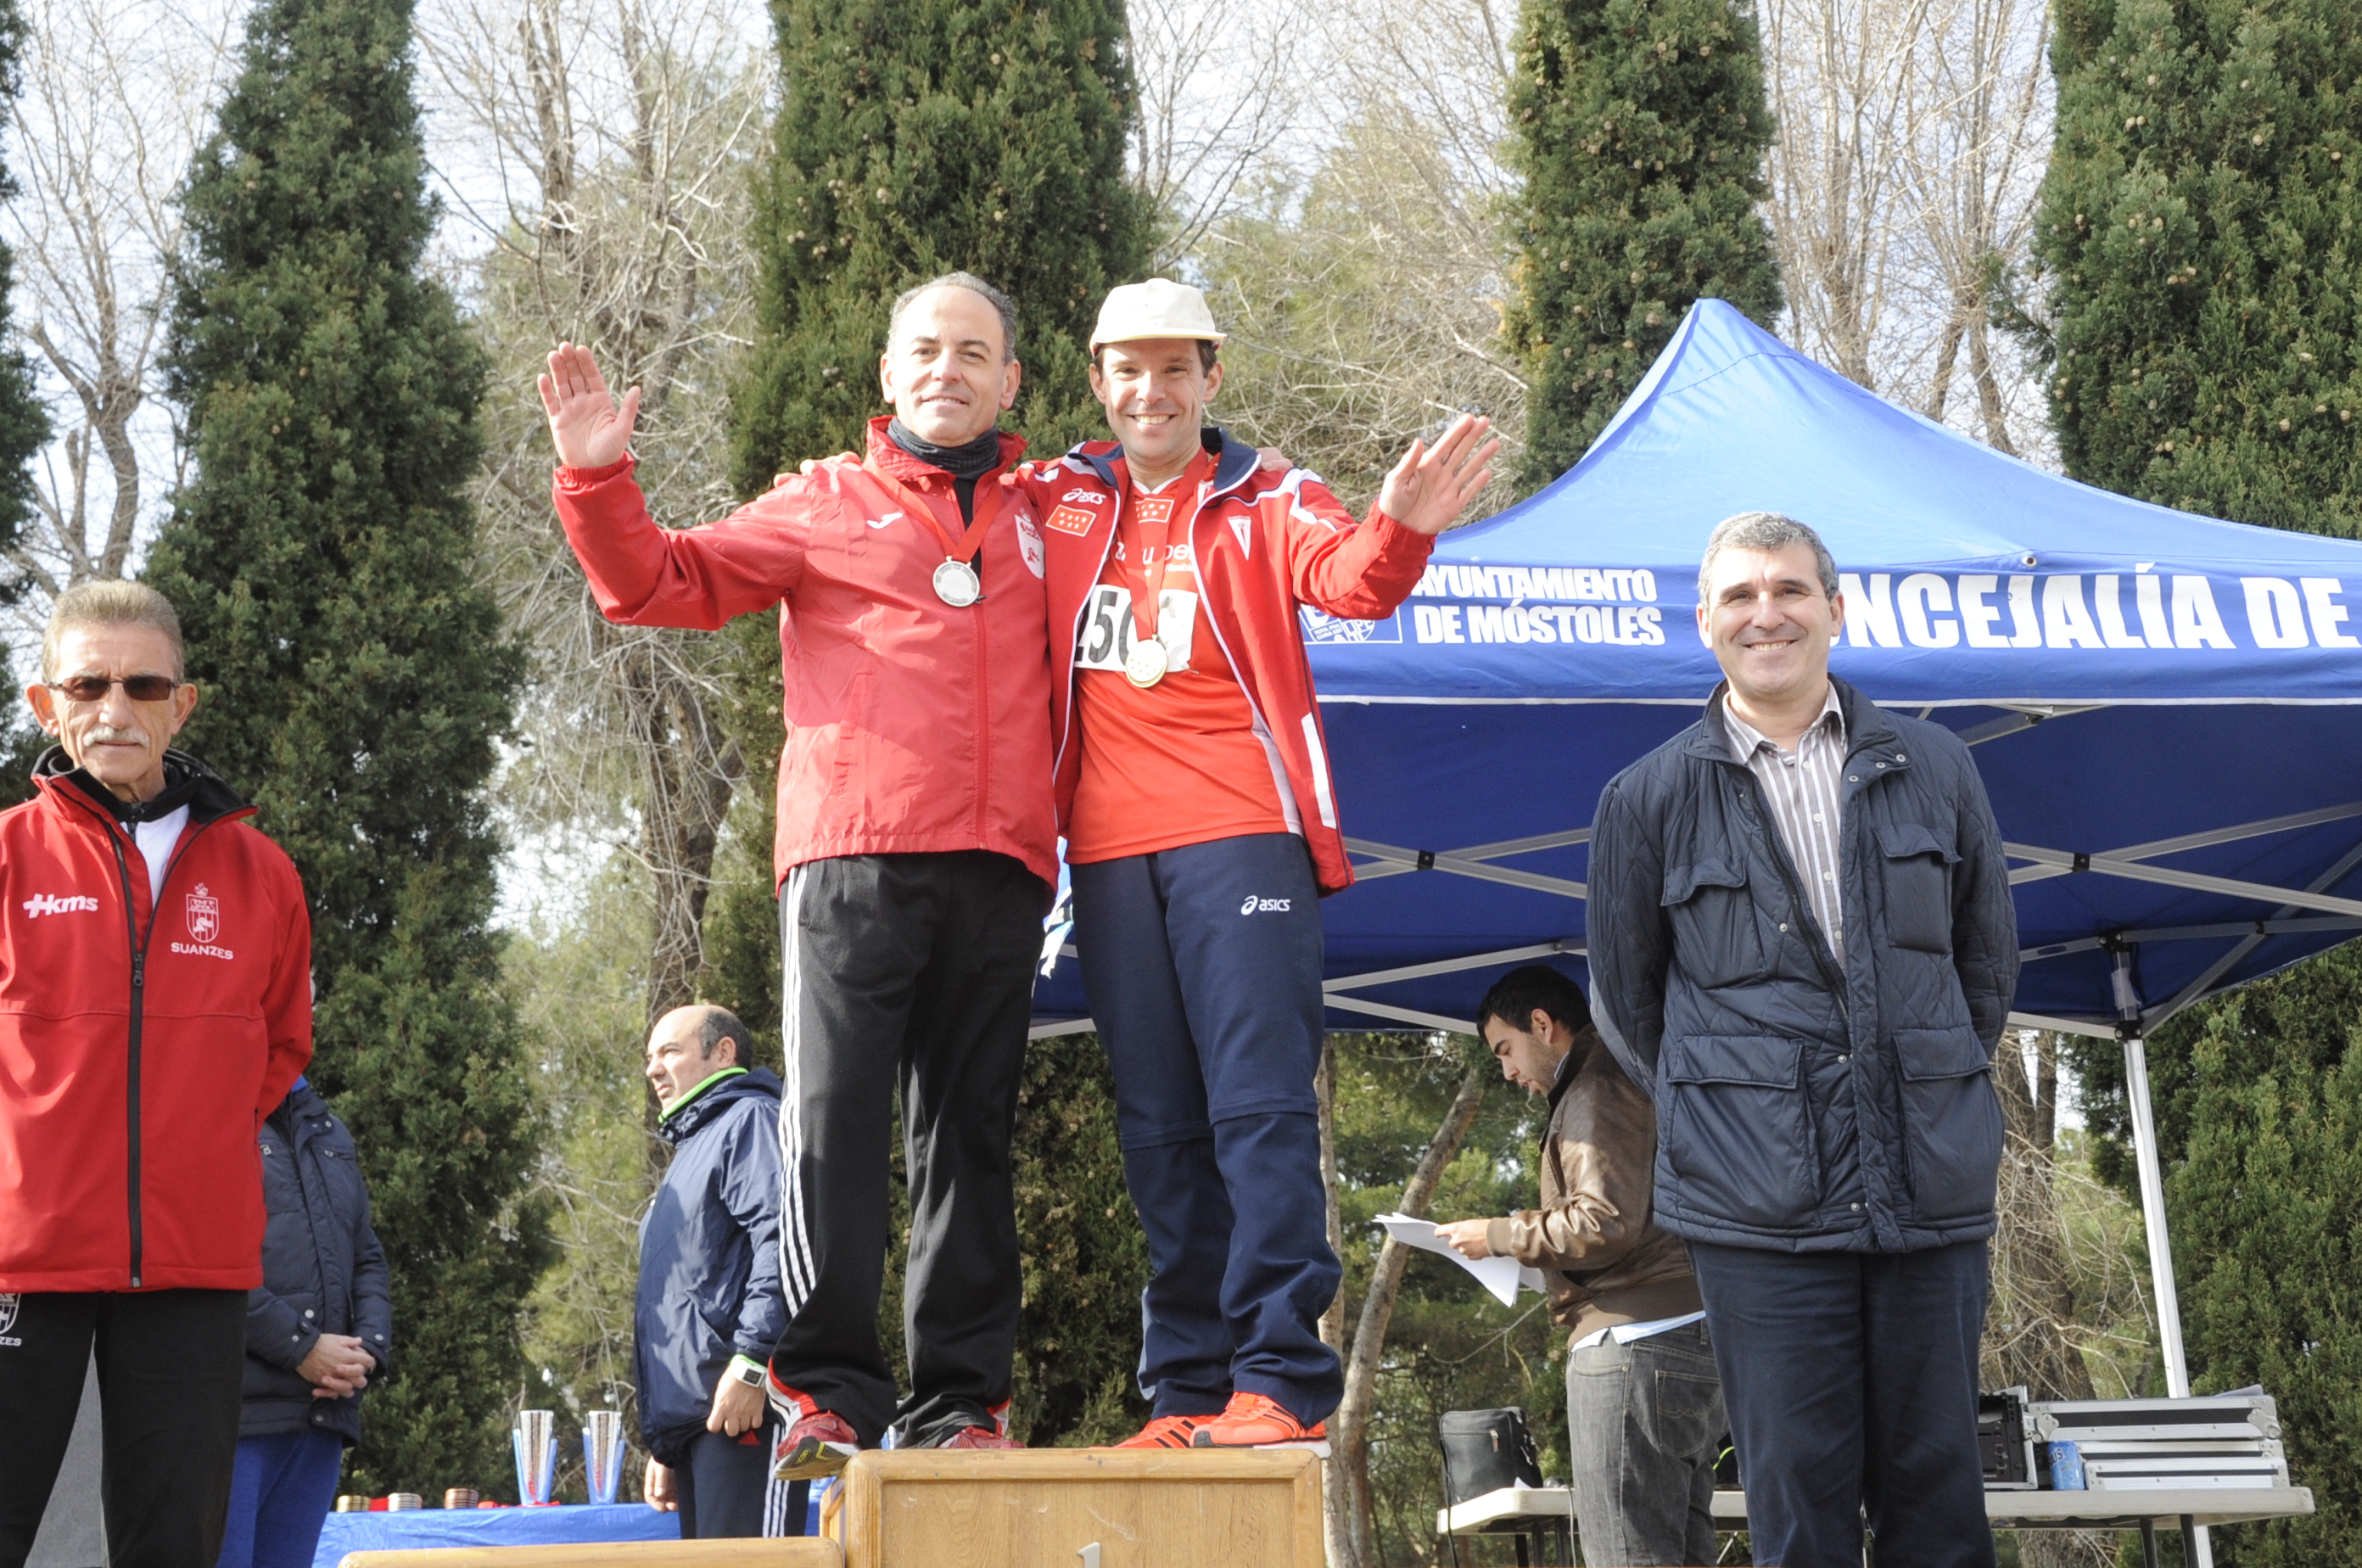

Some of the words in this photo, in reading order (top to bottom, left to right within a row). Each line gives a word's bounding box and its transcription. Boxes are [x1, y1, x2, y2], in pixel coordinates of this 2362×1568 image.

[1411, 564, 1658, 602] AYUNTAMIENTO
[1413, 605, 1466, 644] DE
[1466, 598, 1666, 646] MÓSTOLES
[1830, 563, 2237, 648] NCEJALÍA
[2239, 577, 2362, 648] DE
[1258, 899, 1291, 912] asics
[171, 942, 234, 960] SUANZES
